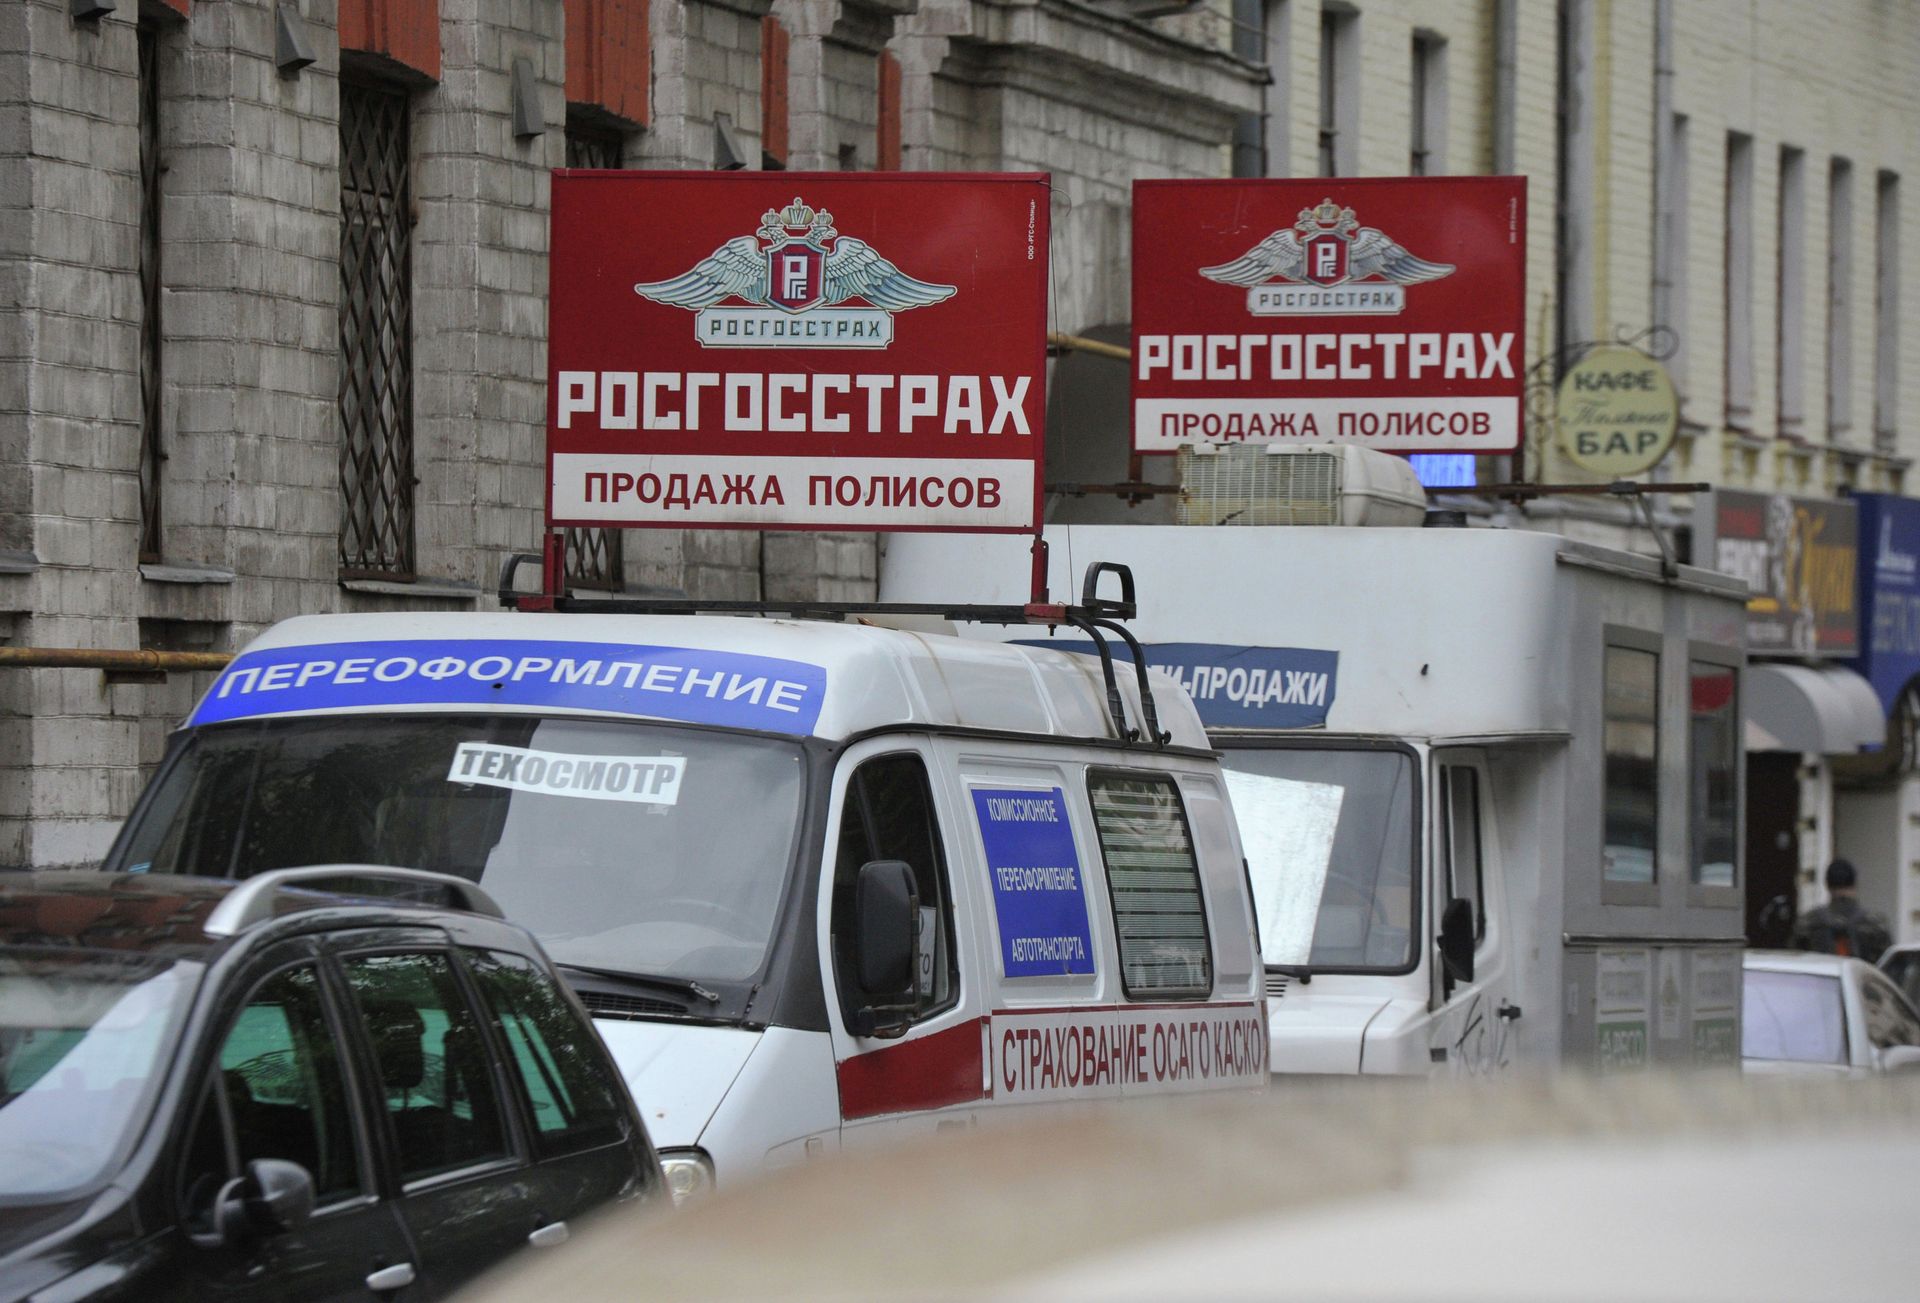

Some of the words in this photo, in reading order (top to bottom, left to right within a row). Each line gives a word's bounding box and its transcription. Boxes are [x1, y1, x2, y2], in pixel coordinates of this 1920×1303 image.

[1259, 292, 1396, 306] РОСГОССТРАХ
[710, 319, 881, 337] РОСГОССТРАХ
[1138, 333, 1516, 381] РОСГОССТРАХ
[1574, 369, 1658, 392] КАФЕ
[557, 370, 1032, 435] РОСГОССТРАХ
[1160, 414, 1320, 442] ПРОДАЖА
[1338, 412, 1491, 437] ПОЛИСОВ
[1576, 431, 1658, 456] БАР
[584, 472, 786, 510] ПРОДАЖА
[808, 474, 1001, 508] ПОЛИСОВ
[217, 656, 810, 714] ПЕРЕОФОРМЛЕНИЕ
[460, 748, 678, 796] ТЕХОСМОТР
[986, 798, 1059, 822] КОМИССИОННОЕ
[996, 866, 1078, 891] ПЕРЕОФОРМЛЕНИЕ
[1011, 936, 1085, 962] АВТОТРАНСПОРТА
[1002, 1023, 1149, 1093] СТРАХОВАНИЕ
[1153, 1020, 1211, 1083] ОСАГО
[1213, 1017, 1261, 1077] КАСКО
